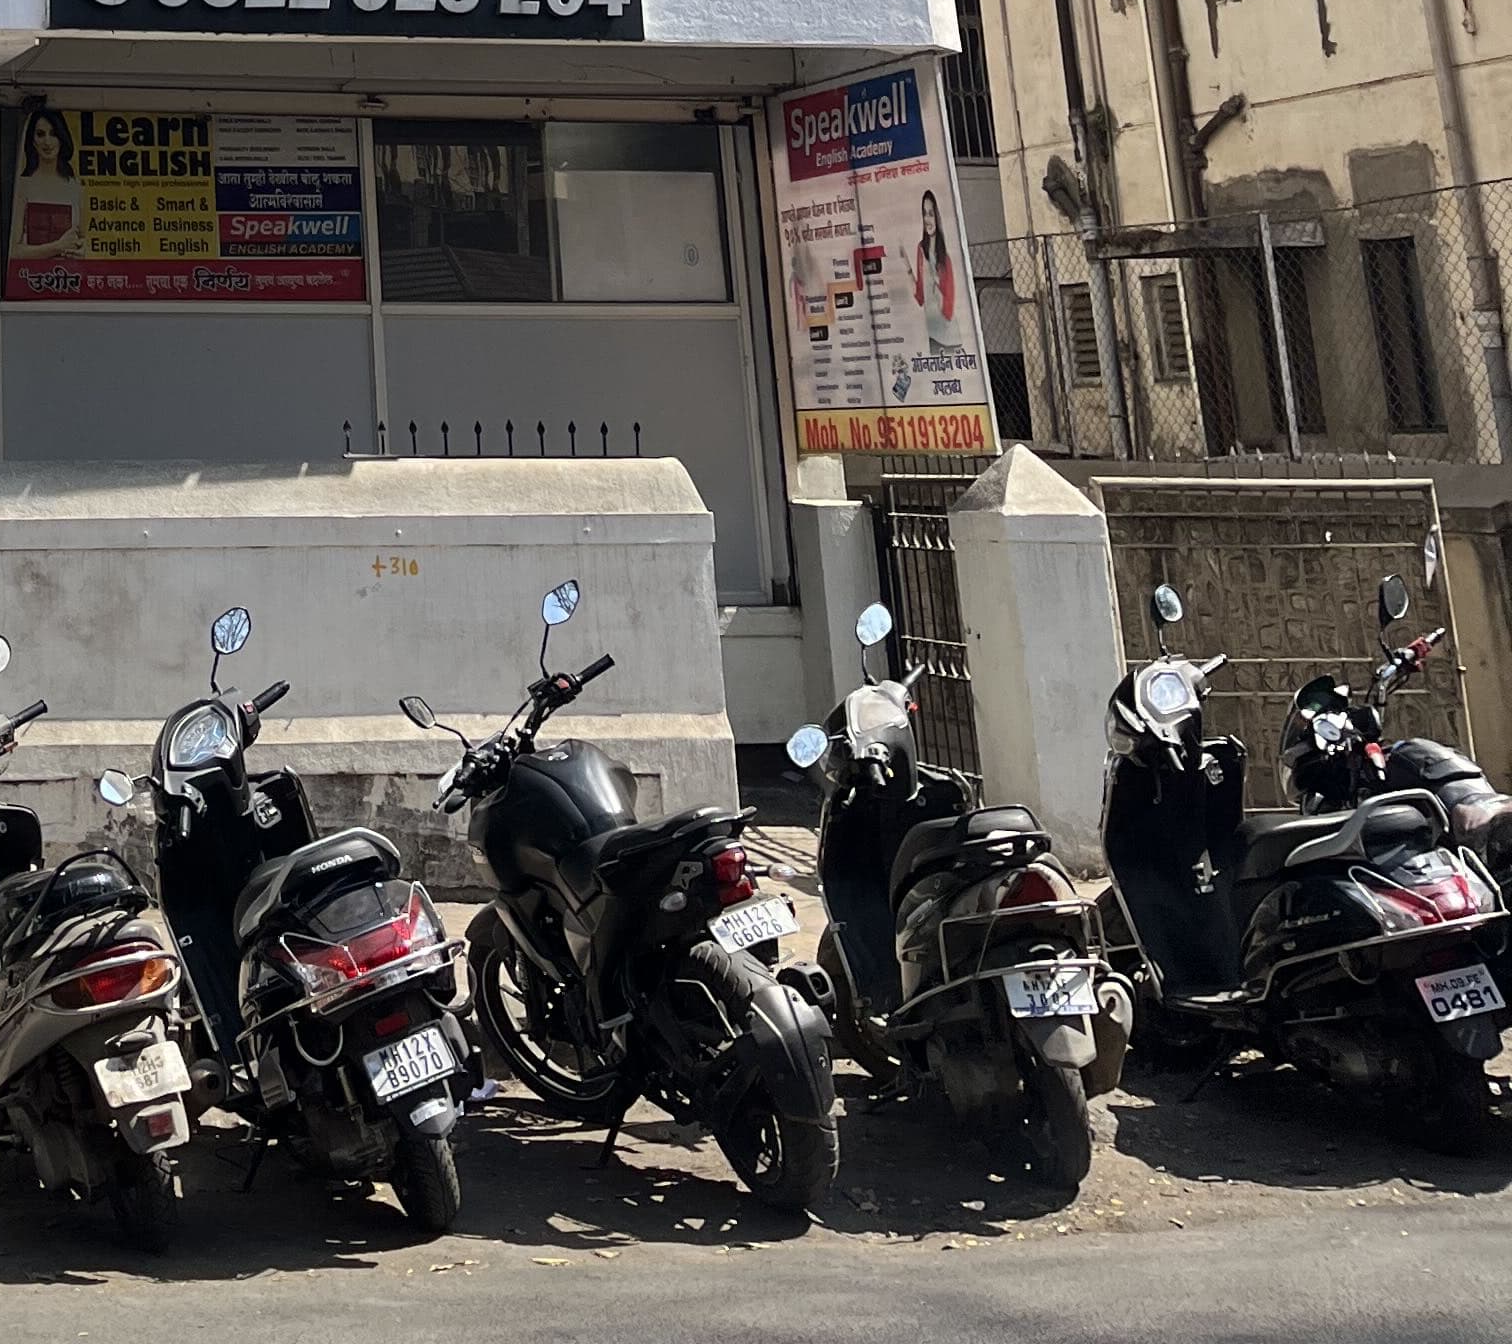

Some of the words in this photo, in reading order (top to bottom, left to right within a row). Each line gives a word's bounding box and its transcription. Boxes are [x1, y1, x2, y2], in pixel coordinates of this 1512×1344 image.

[81, 111, 209, 147] Learn
[791, 80, 907, 156] Speakwell
[79, 150, 211, 177] ENGLISH
[816, 146, 848, 168] English
[850, 139, 893, 160] Academy
[90, 196, 126, 211] Basic
[130, 196, 140, 211] &
[156, 196, 196, 211] Smart
[199, 196, 209, 211] &
[88, 217, 146, 232] Advance
[153, 218, 214, 232] Business
[230, 215, 349, 239] Speakwell
[91, 238, 141, 255] English
[159, 238, 209, 255] English
[229, 244, 286, 255] ENGLISH
[289, 244, 354, 255] ACADEMY
[805, 417, 845, 450] Mob.
[311, 854, 353, 874] HONDA
[722, 902, 772, 931] MH12T
[734, 918, 784, 947] G6026
[1431, 985, 1498, 1017] 0481
[378, 1032, 436, 1070] MH12X
[388, 1051, 443, 1089] B9070
